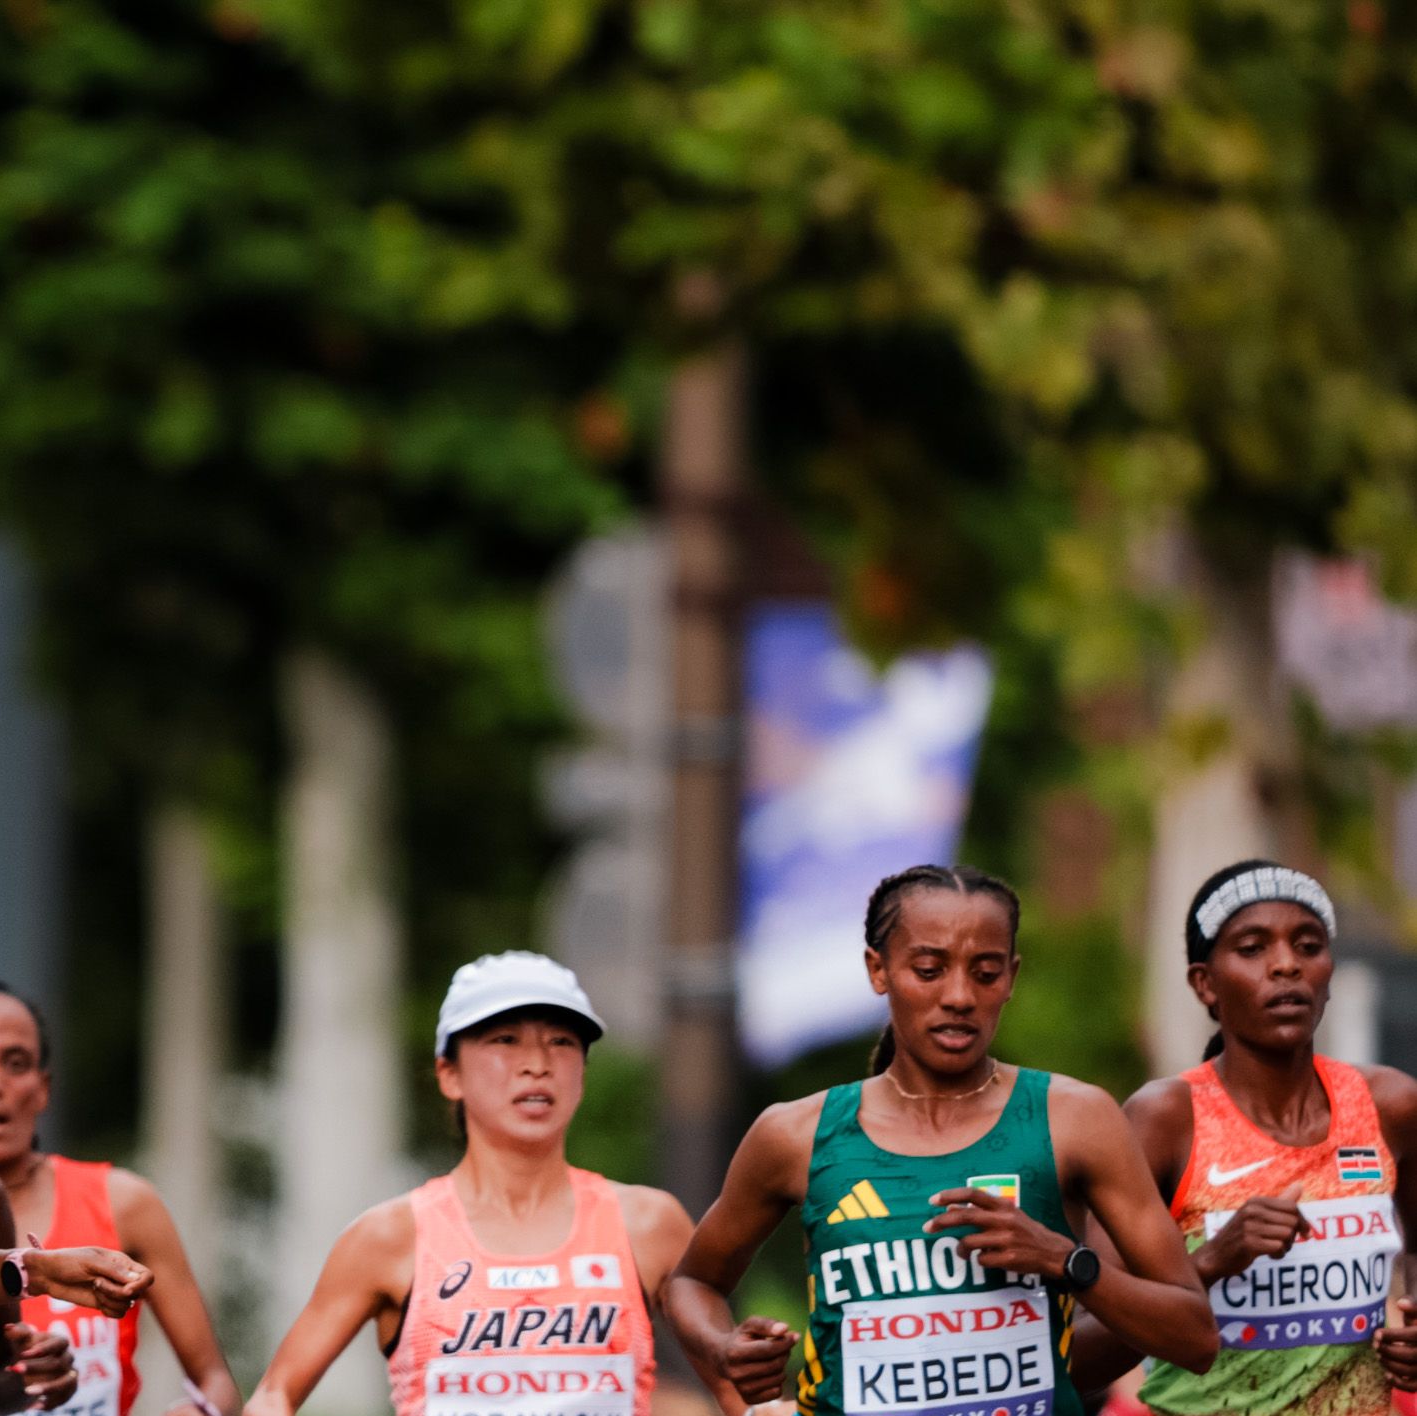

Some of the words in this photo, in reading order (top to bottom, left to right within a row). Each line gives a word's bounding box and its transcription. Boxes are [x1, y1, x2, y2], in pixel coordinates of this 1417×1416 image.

[1222, 1252, 1386, 1309] CHERONO
[440, 1303, 618, 1355] JAPAN
[847, 1299, 1045, 1343] HONDA
[435, 1371, 625, 1395] HONDA
[858, 1344, 1041, 1405] KEBEDE
